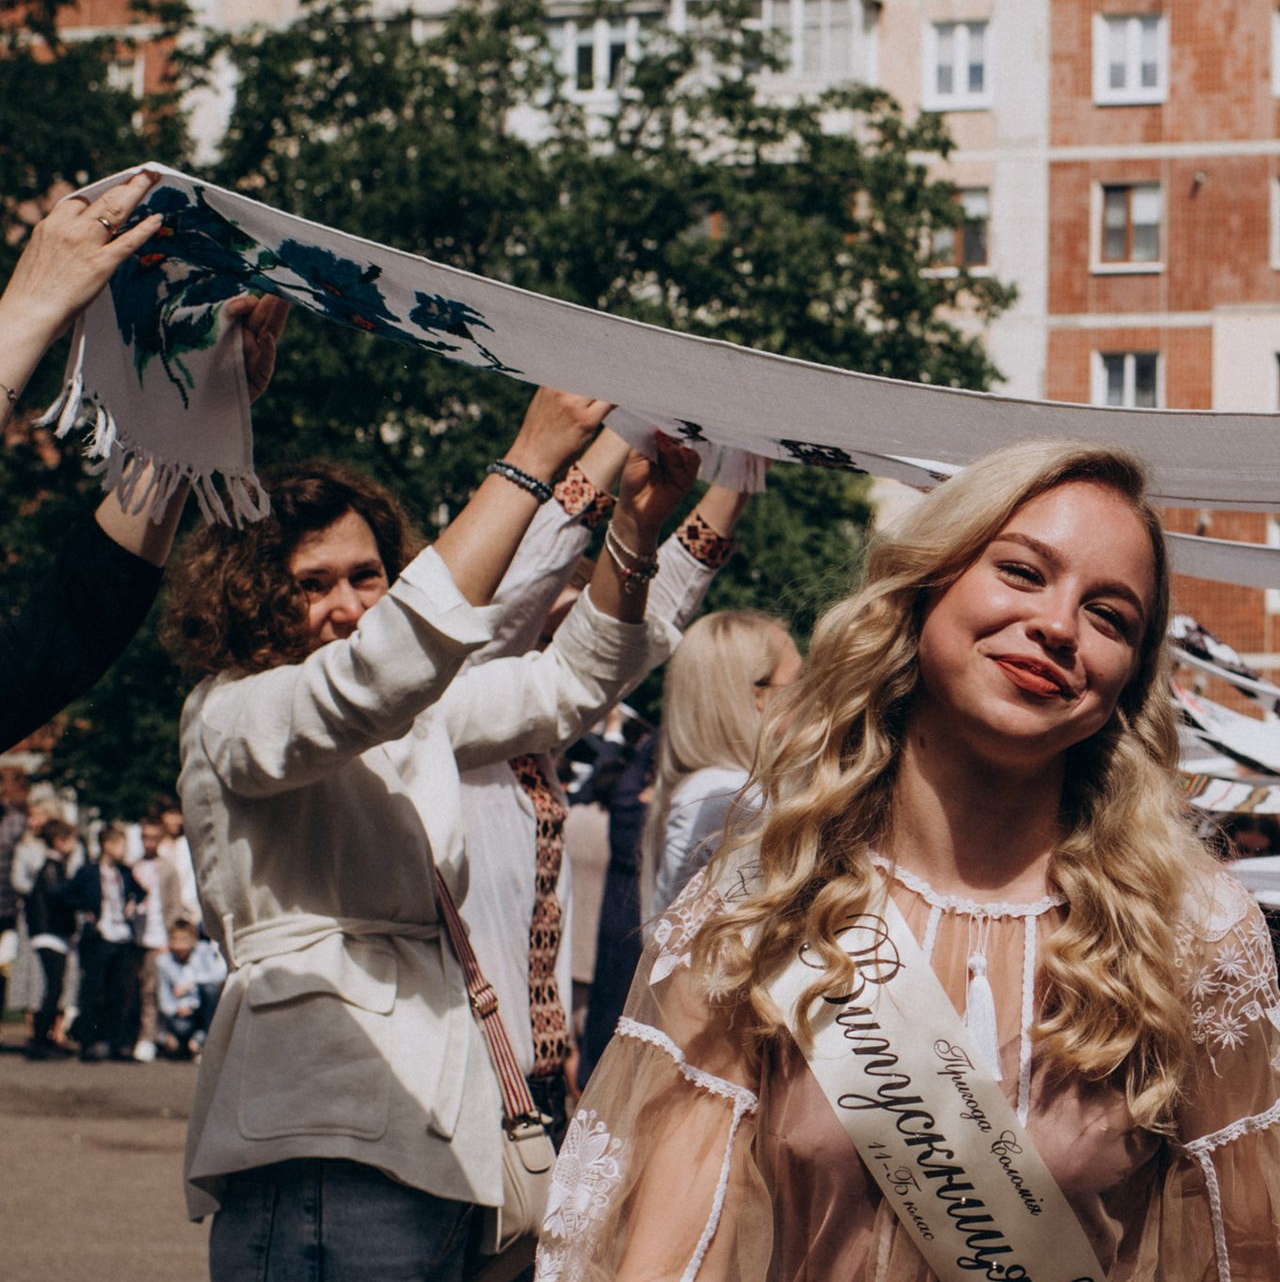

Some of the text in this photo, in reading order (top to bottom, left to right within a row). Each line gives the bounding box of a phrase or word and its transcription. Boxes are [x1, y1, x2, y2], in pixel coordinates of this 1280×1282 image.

[867, 1141, 934, 1241] 11-Б клас
[933, 1039, 1043, 1216] Пригода Соломія
